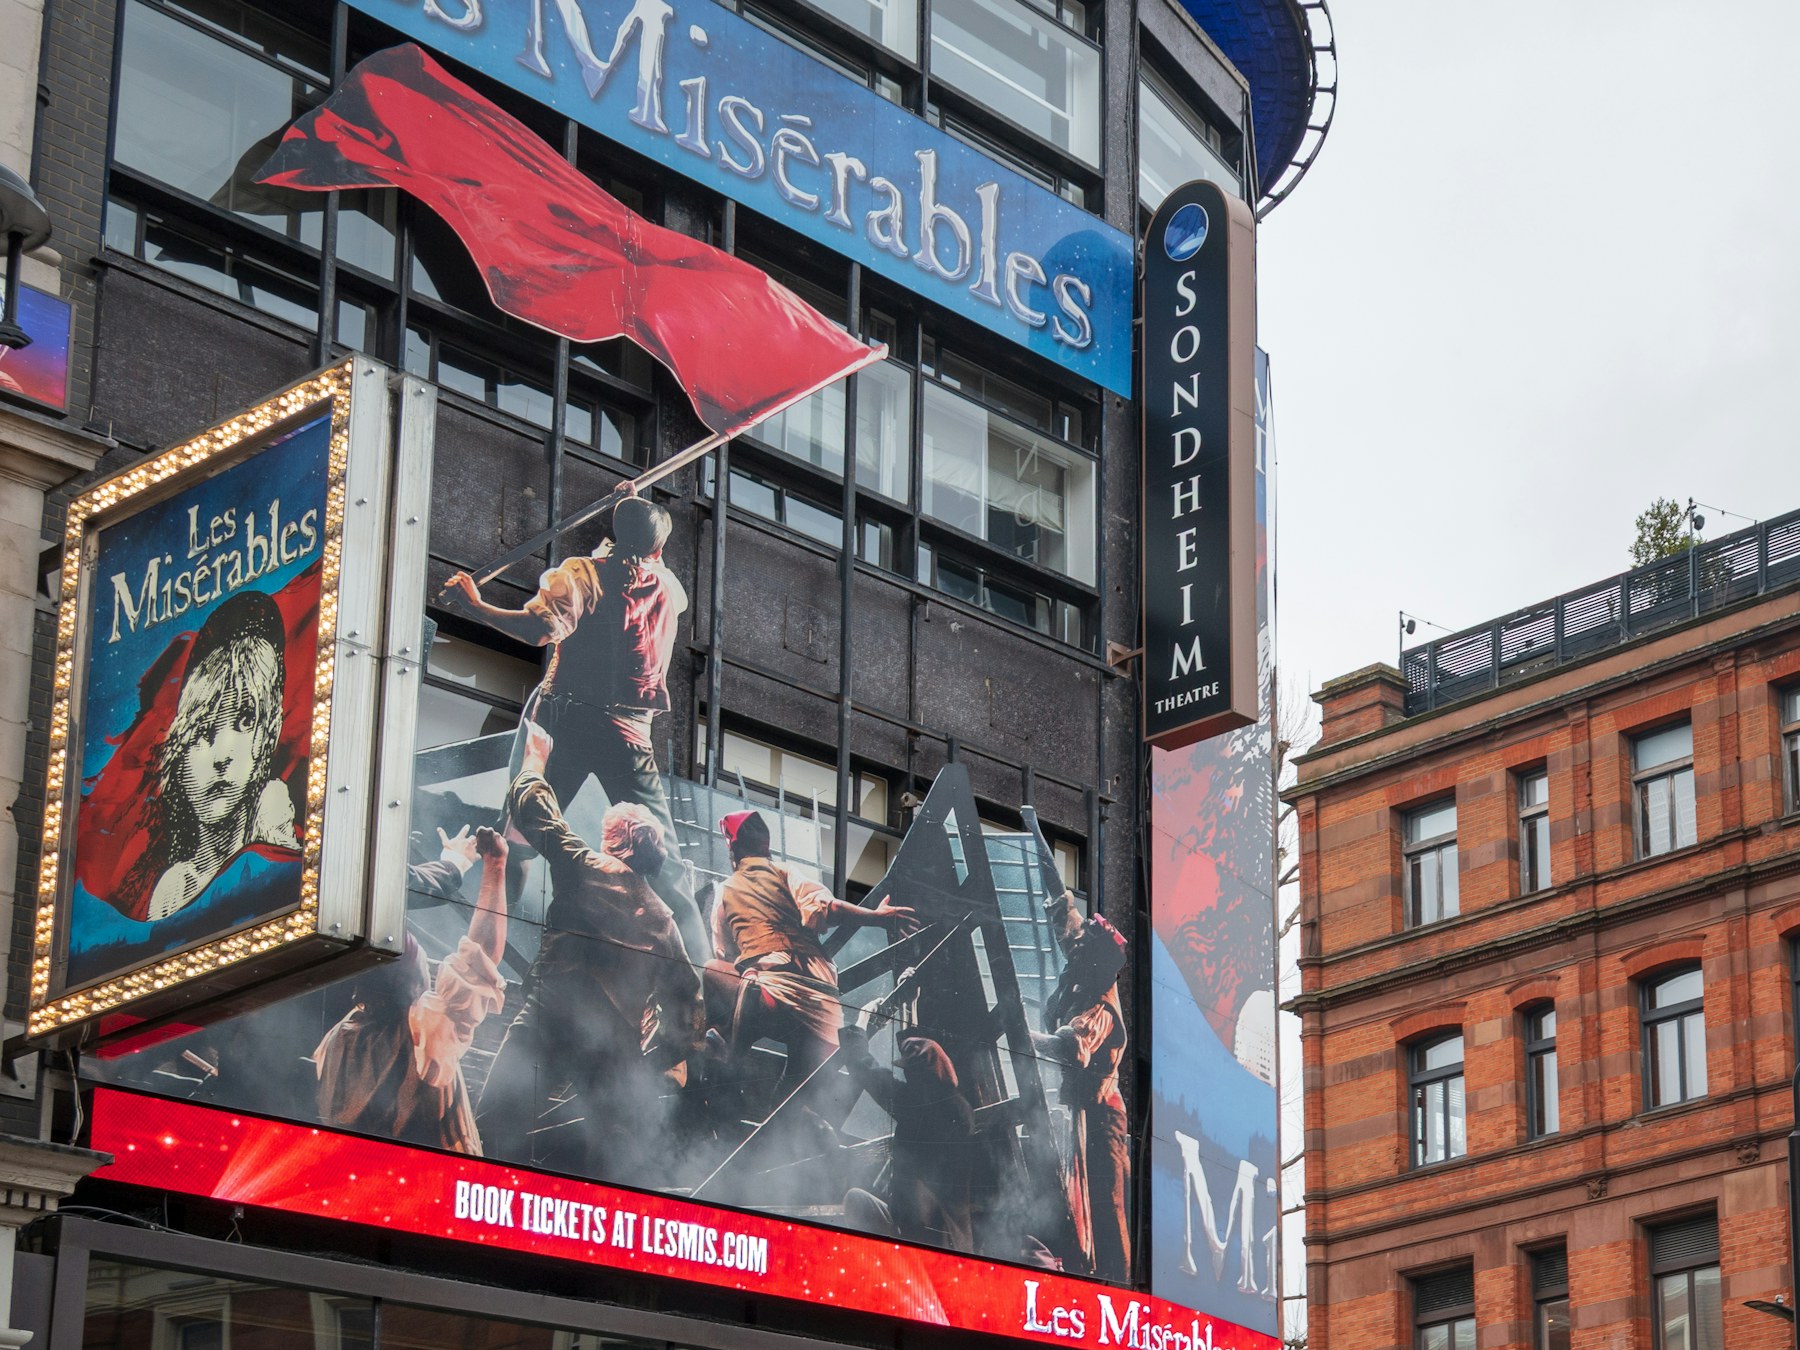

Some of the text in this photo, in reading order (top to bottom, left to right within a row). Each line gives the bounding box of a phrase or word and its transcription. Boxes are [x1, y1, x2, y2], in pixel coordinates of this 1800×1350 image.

[1169, 270, 1207, 682] SONDHEIM
[108, 497, 318, 644] Misérables
[187, 504, 237, 559] Les
[1154, 681, 1220, 714] THEATRE
[455, 1179, 768, 1275] BOOK TICKETS AT LESMIS.COM
[1023, 1279, 1086, 1340] Les
